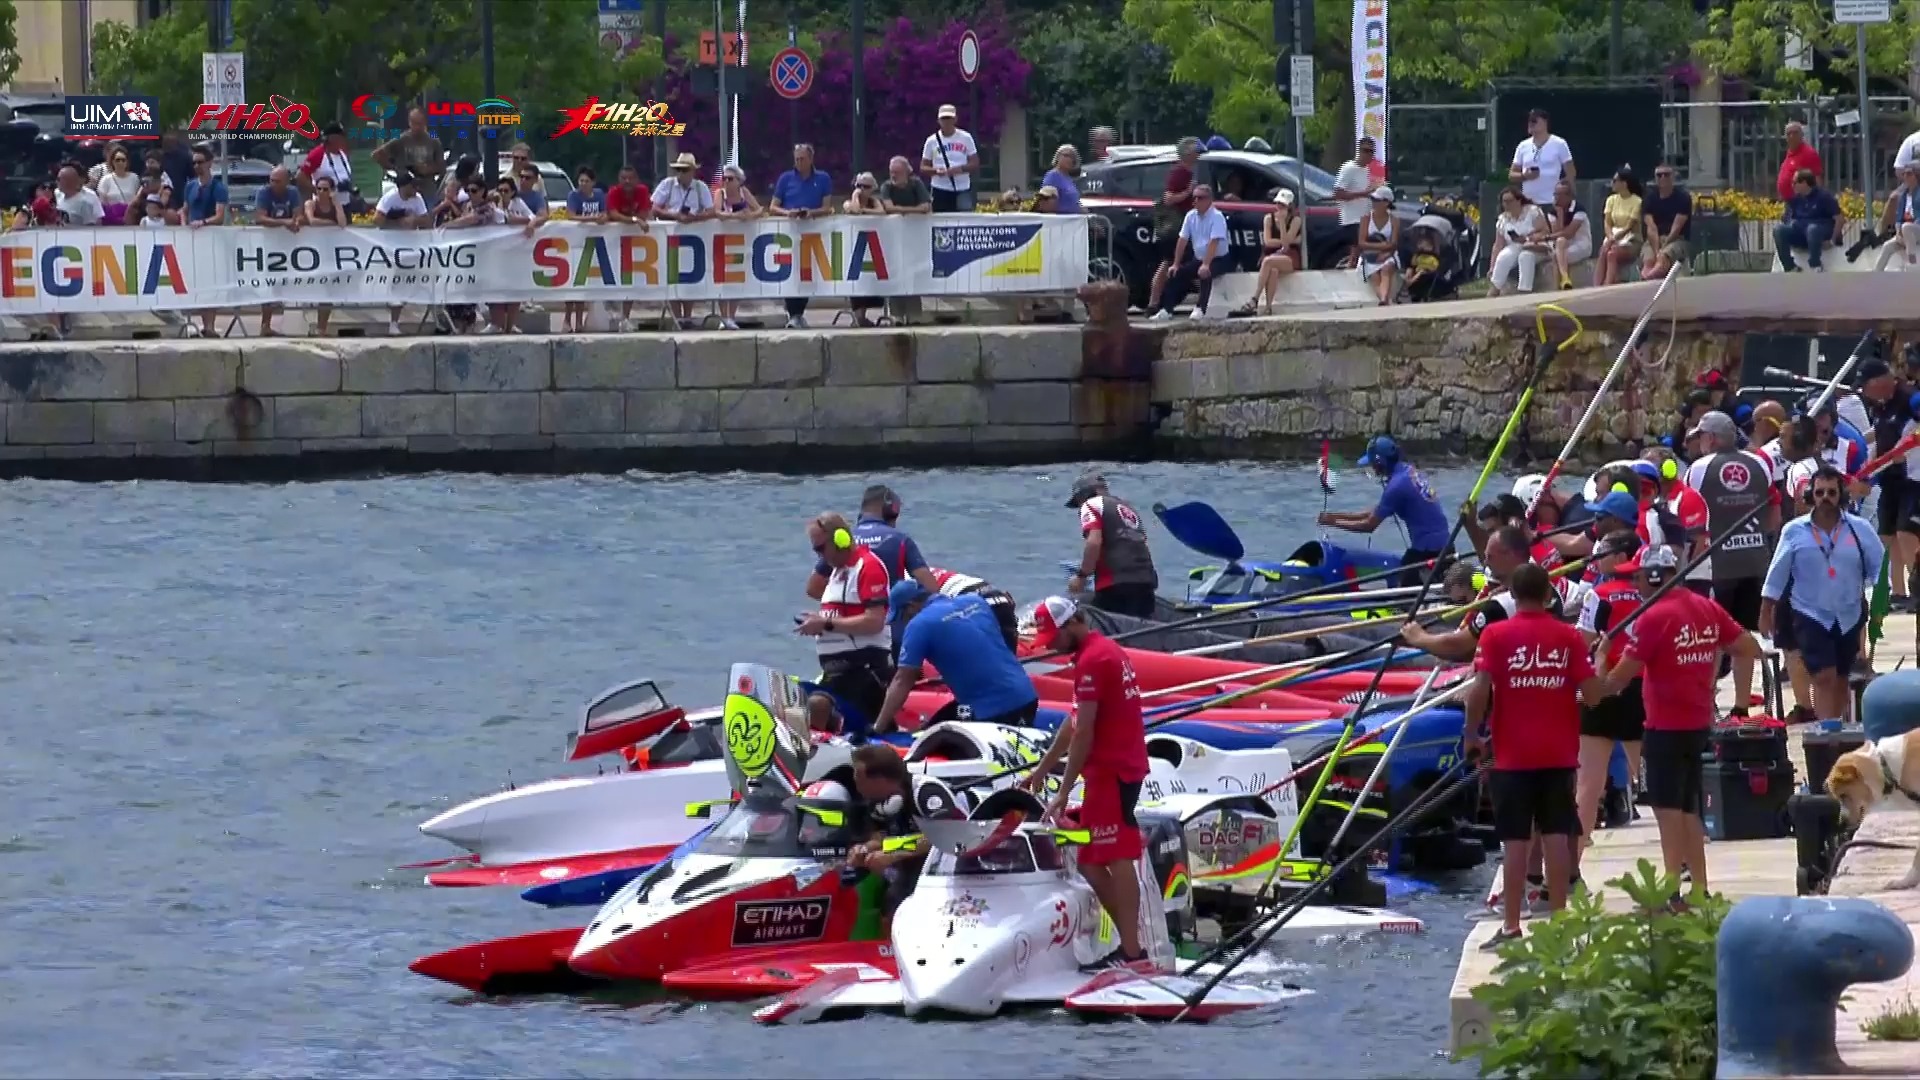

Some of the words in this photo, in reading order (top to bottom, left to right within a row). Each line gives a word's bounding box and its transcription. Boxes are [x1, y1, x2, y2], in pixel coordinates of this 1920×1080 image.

[956, 227, 1017, 236] FEDERAZIONE
[956, 235, 994, 243] ITALIANA
[956, 241, 1016, 251] MOTONAUTICA
[236, 246, 320, 272] H2O
[334, 244, 477, 270] RACING
[532, 231, 889, 287] SARDEGNA
[1, 244, 188, 298] EGNA
[237, 275, 352, 288] POWERBOAT
[365, 274, 477, 285] PROMOTION
[1724, 535, 1762, 550] ORLEN
[1199, 832, 1239, 845] DAC
[743, 903, 822, 923] ETIHAD
[754, 924, 805, 938] AIRWAYS
